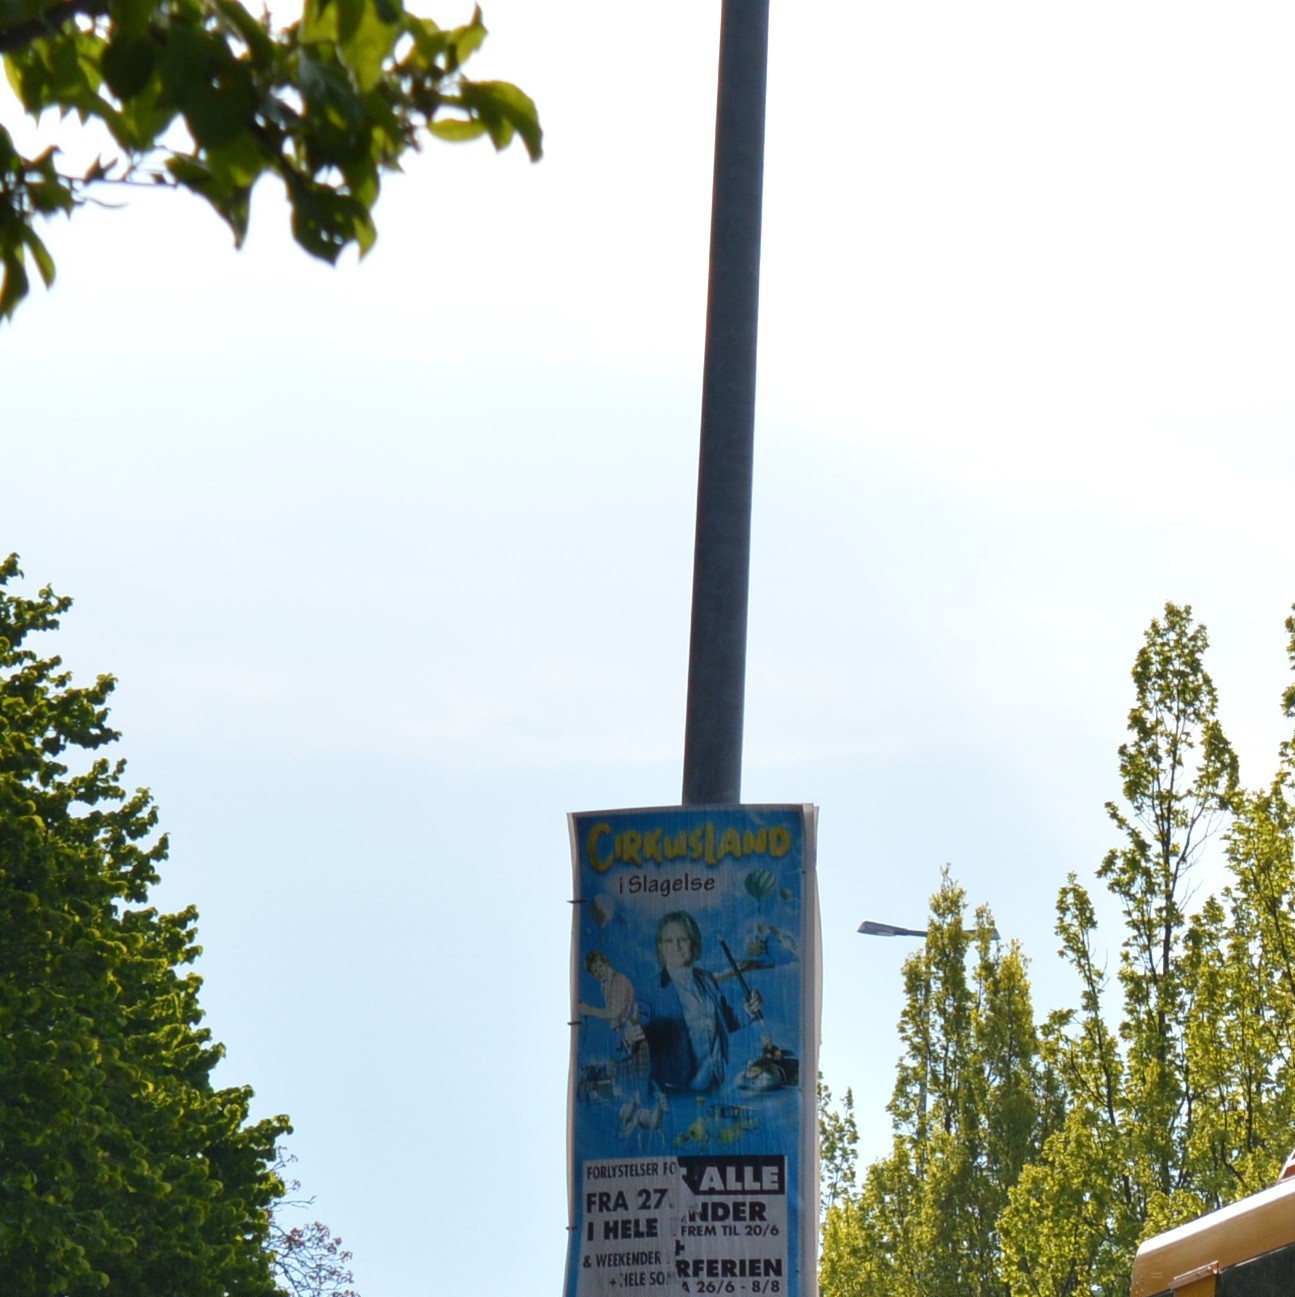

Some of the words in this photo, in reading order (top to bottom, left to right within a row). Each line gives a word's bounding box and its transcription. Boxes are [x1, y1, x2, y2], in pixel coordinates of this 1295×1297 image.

[618, 877, 624, 895] i
[628, 873, 716, 897] Slagelse
[586, 1162, 659, 1180] FORLYSTELSER
[699, 1165, 780, 1191] ALLE
[586, 1190, 629, 1214] FRA
[603, 1218, 658, 1240] HELE
[681, 1225, 717, 1237] FREM
[721, 1224, 740, 1237] TIL
[744, 1224, 780, 1238] 20/6
[583, 1254, 592, 1268] &
[595, 1250, 661, 1268] WEEKENDER
[696, 1280, 736, 1294] 26/6
[751, 1280, 781, 1294] 8/8
